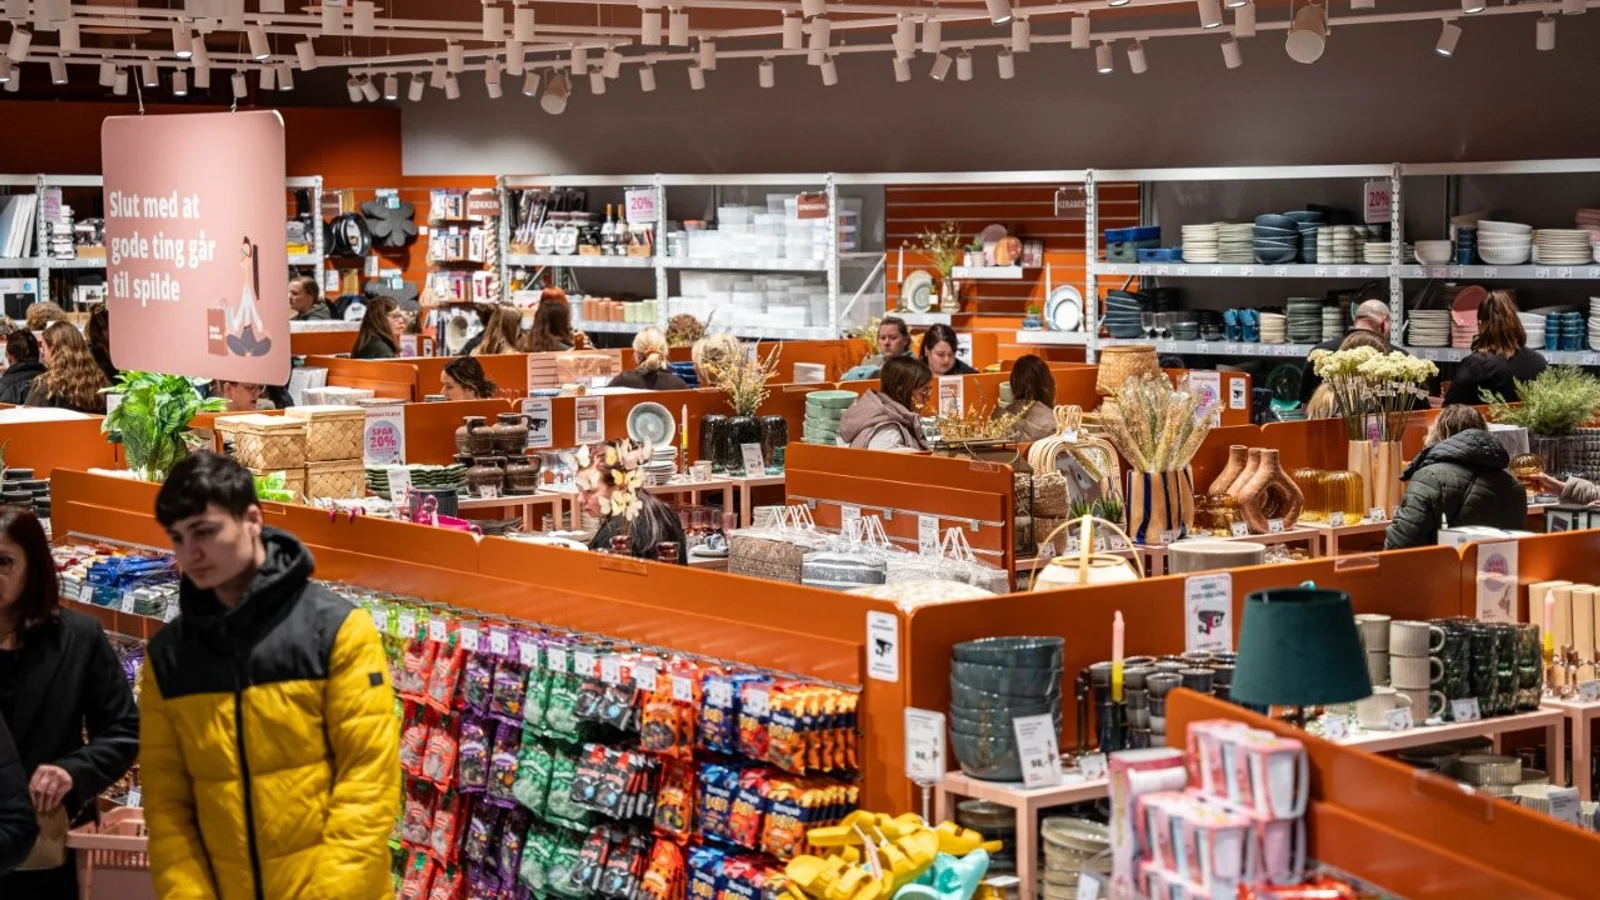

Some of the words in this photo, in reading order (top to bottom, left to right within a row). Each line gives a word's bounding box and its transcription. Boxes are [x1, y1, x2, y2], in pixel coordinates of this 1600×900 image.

[110, 191, 139, 218] Slut
[144, 190, 178, 218] med
[183, 193, 200, 218] at
[631, 196, 654, 210] 20%
[1369, 190, 1390, 207] 20%
[111, 231, 148, 265] gode
[152, 231, 185, 268] ting
[188, 229, 216, 269] går
[112, 270, 129, 298] til
[133, 272, 180, 307] spilde
[372, 427, 393, 436] SPAR
[369, 436, 396, 449] 20%
